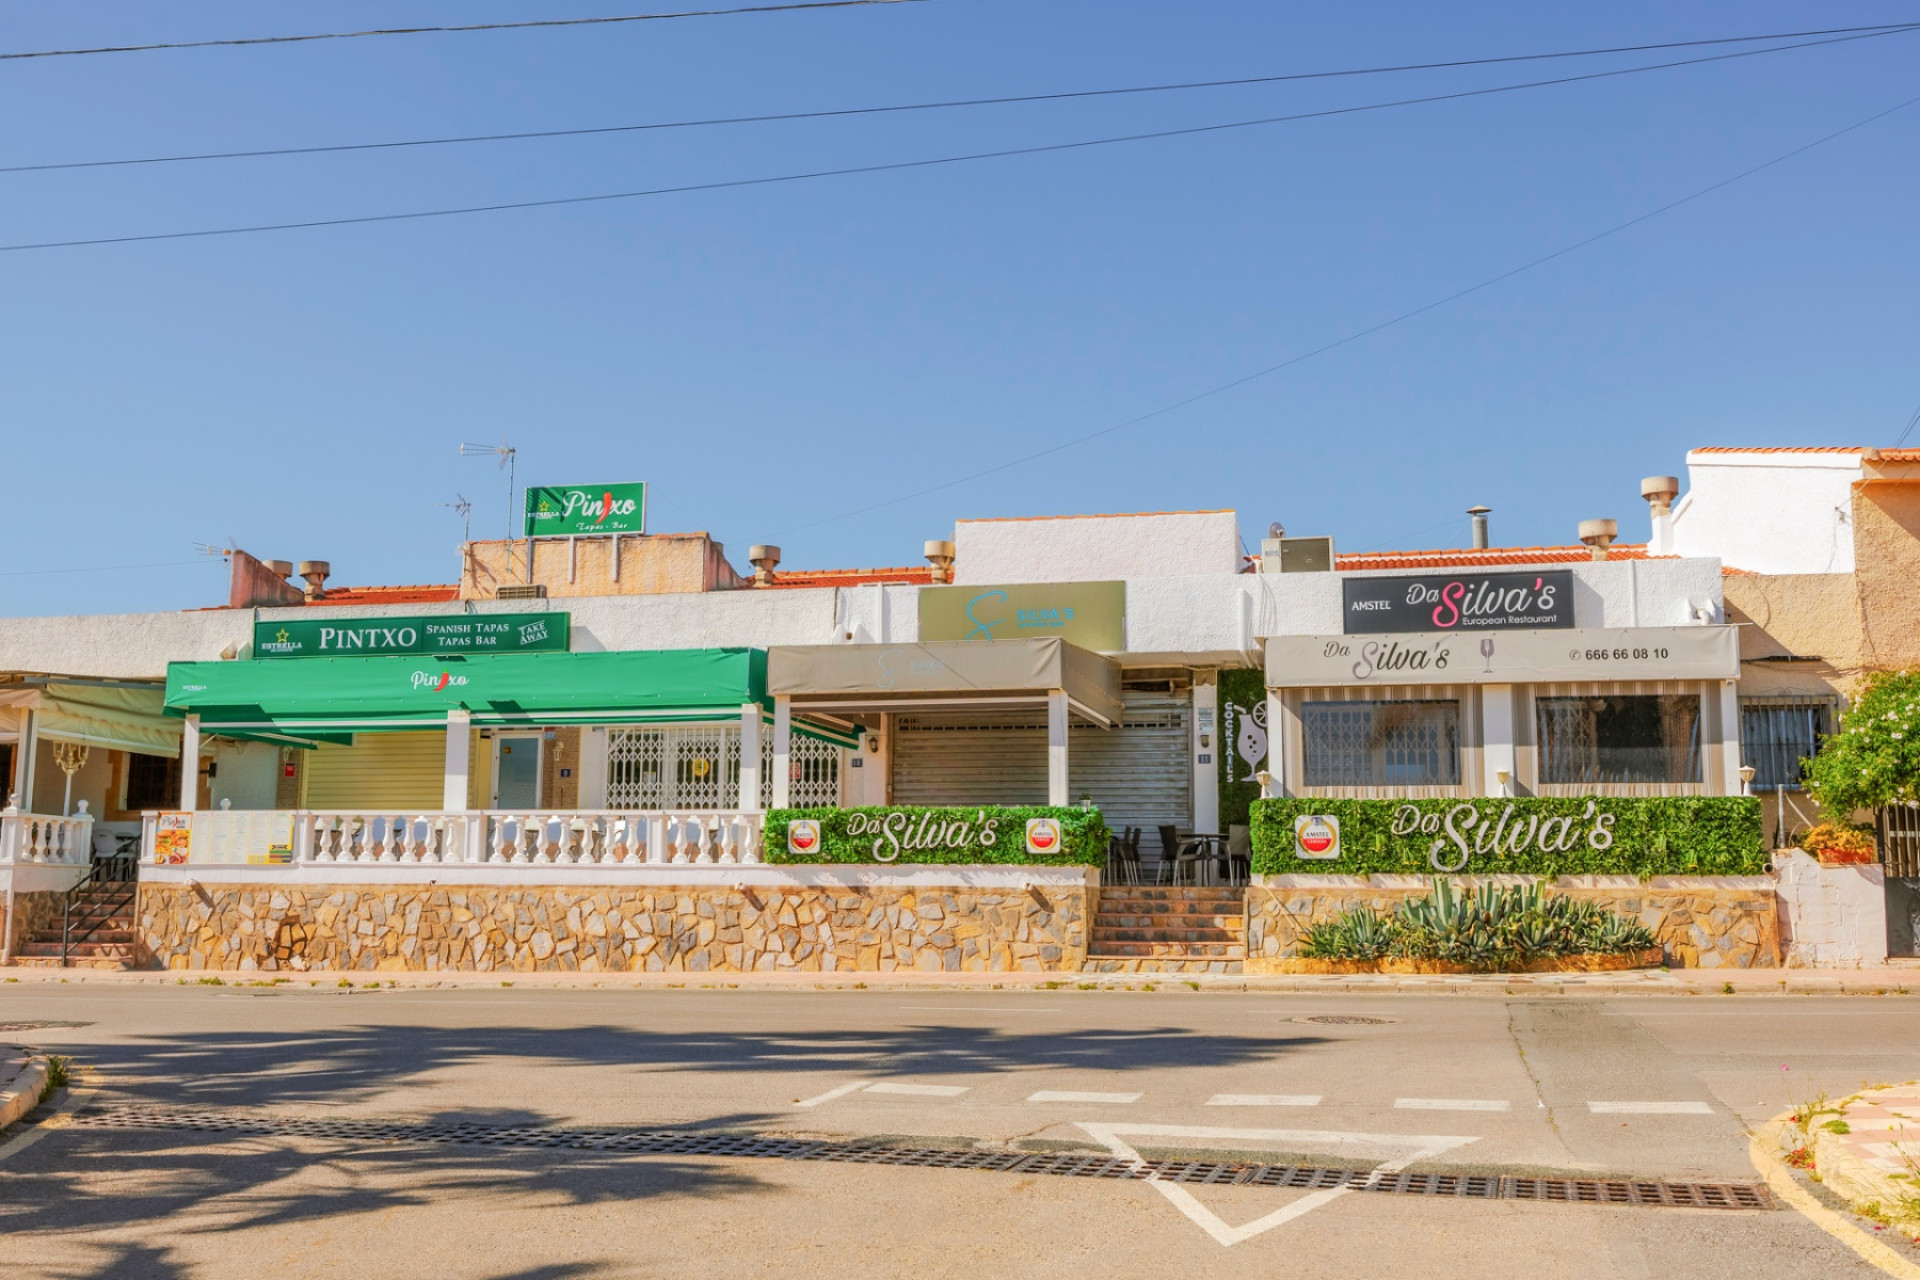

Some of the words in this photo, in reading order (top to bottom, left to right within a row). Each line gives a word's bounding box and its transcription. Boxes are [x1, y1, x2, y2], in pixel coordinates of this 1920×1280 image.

[576, 522, 603, 532] Tapas
[1351, 600, 1391, 611] AMSTEL
[1406, 583, 1440, 605] Da
[1432, 577, 1557, 628] Silva's
[1016, 607, 1075, 621] SILVA'S
[1462, 616, 1506, 626] European
[1508, 614, 1557, 624] Restaurant
[426, 624, 471, 634] SPANISH
[475, 623, 510, 633] TAPAS
[518, 622, 546, 635] TAKE
[319, 627, 417, 649] PINTXO
[438, 637, 471, 646] TAPAS
[476, 636, 497, 645] BAR
[520, 630, 548, 644] AWAY
[261, 642, 302, 650] ESTRELLA
[1323, 641, 1350, 658] Da
[1352, 641, 1450, 680] Silva's
[1585, 649, 1610, 661] 666
[1613, 649, 1629, 661] 66
[1632, 648, 1649, 660] 08
[1653, 648, 1669, 659] 10
[1224, 702, 1234, 783] COCKTAILS
[847, 813, 879, 835] Da
[873, 810, 1000, 863] Silva's
[1391, 804, 1439, 835] Da
[1430, 800, 1615, 872] Silva's
